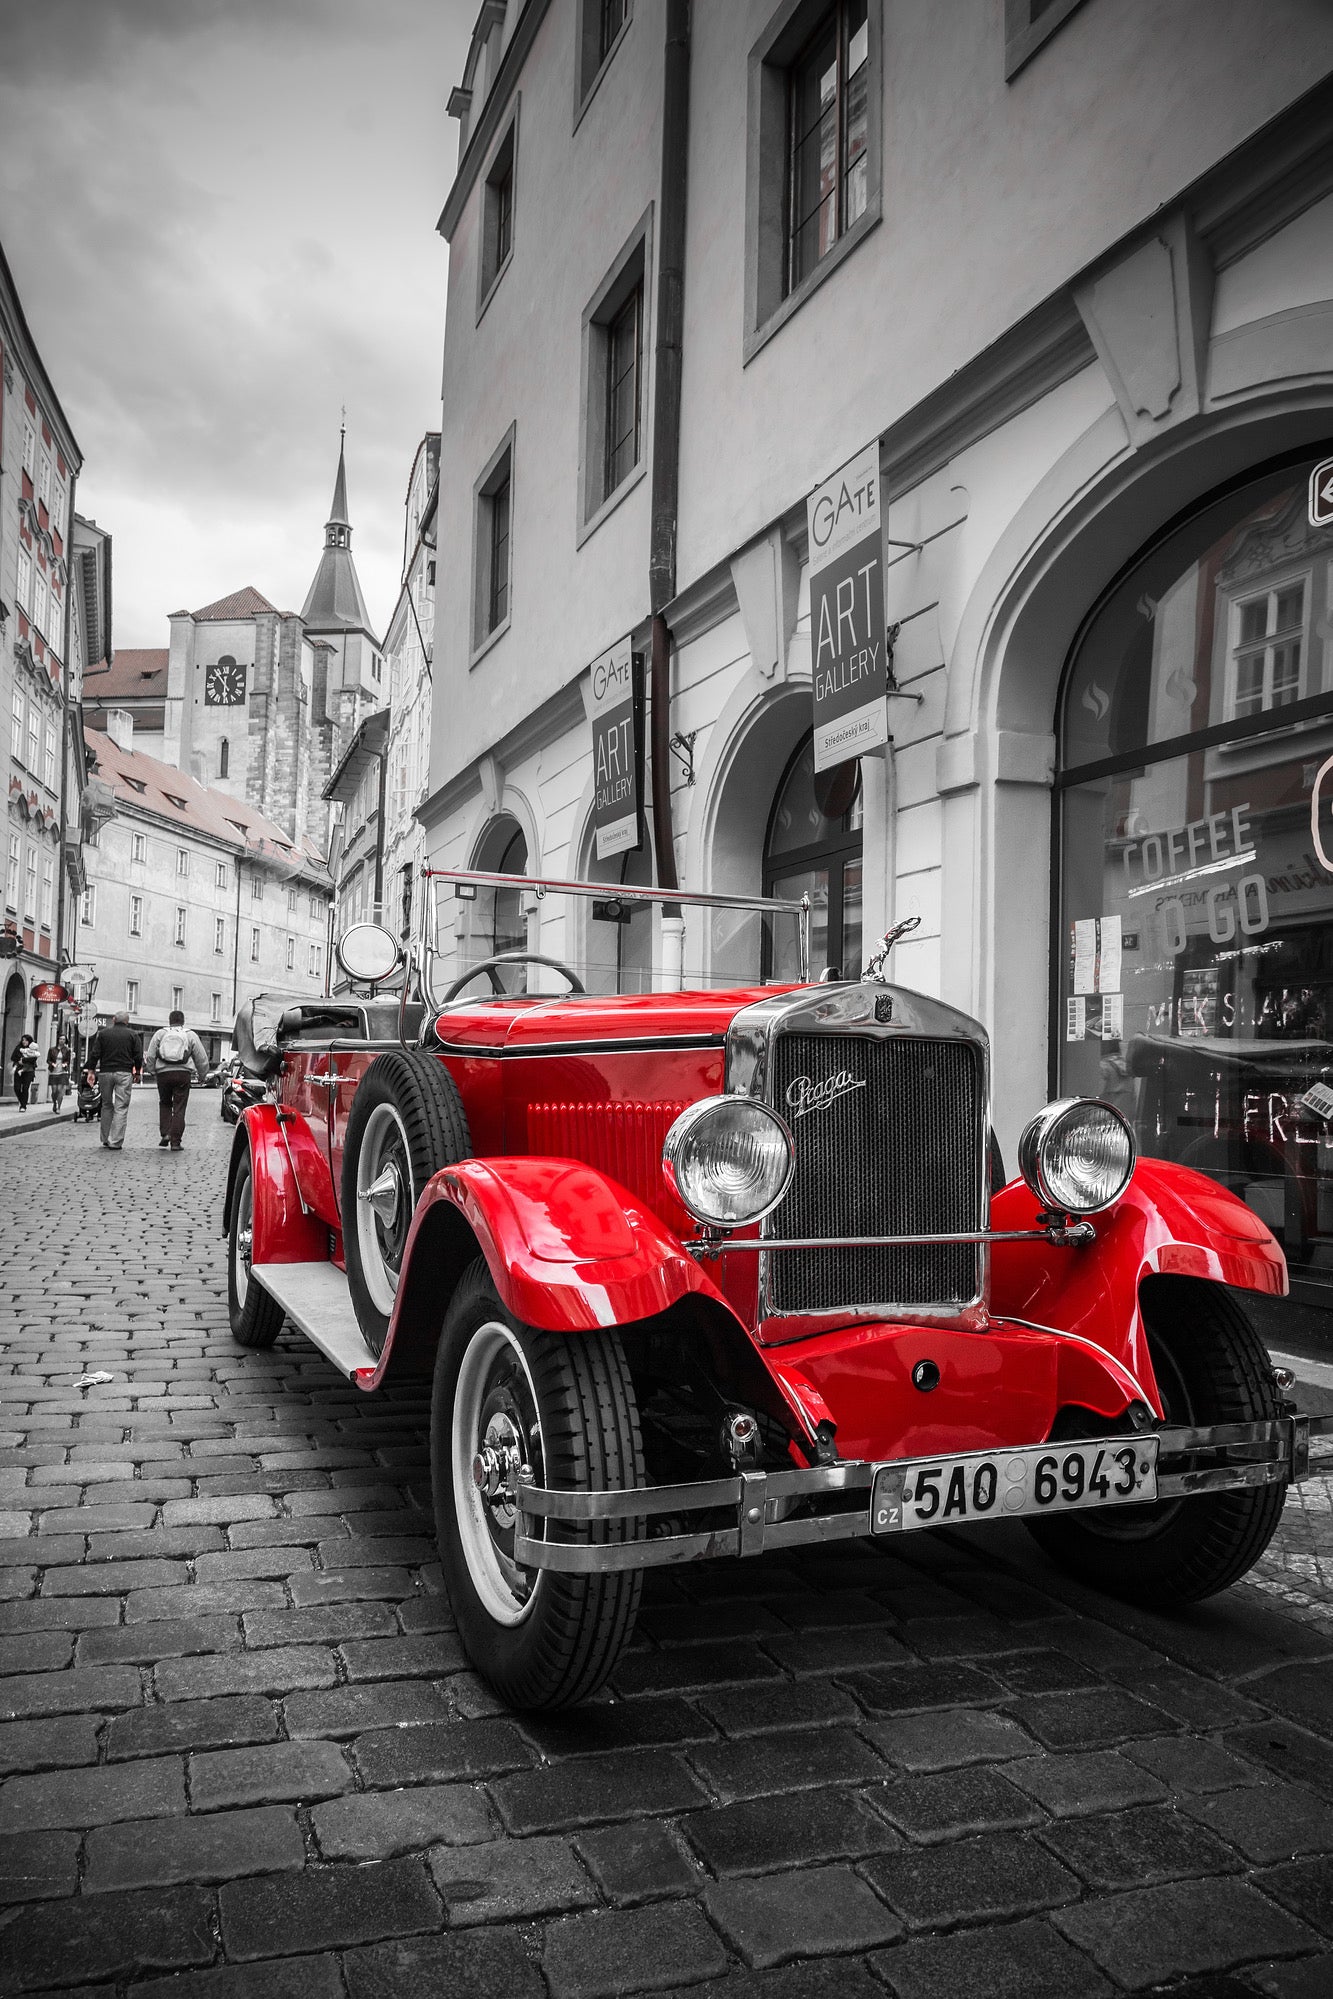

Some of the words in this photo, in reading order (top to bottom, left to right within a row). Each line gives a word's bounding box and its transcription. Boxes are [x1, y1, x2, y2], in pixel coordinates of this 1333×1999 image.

[813, 479, 875, 547] GATE
[816, 559, 877, 669] ART
[593, 658, 629, 700] GATE
[816, 642, 879, 702] GALLERY
[596, 717, 631, 786] ART
[858, 718, 870, 733] kraj
[596, 775, 632, 810] GALLERY
[1123, 802, 1254, 884] COFFEE
[1207, 873, 1269, 943] GO
[786, 1070, 866, 1118] Praga
[1034, 1446, 1137, 1504] 6943
[877, 1508, 899, 1525] CZ
